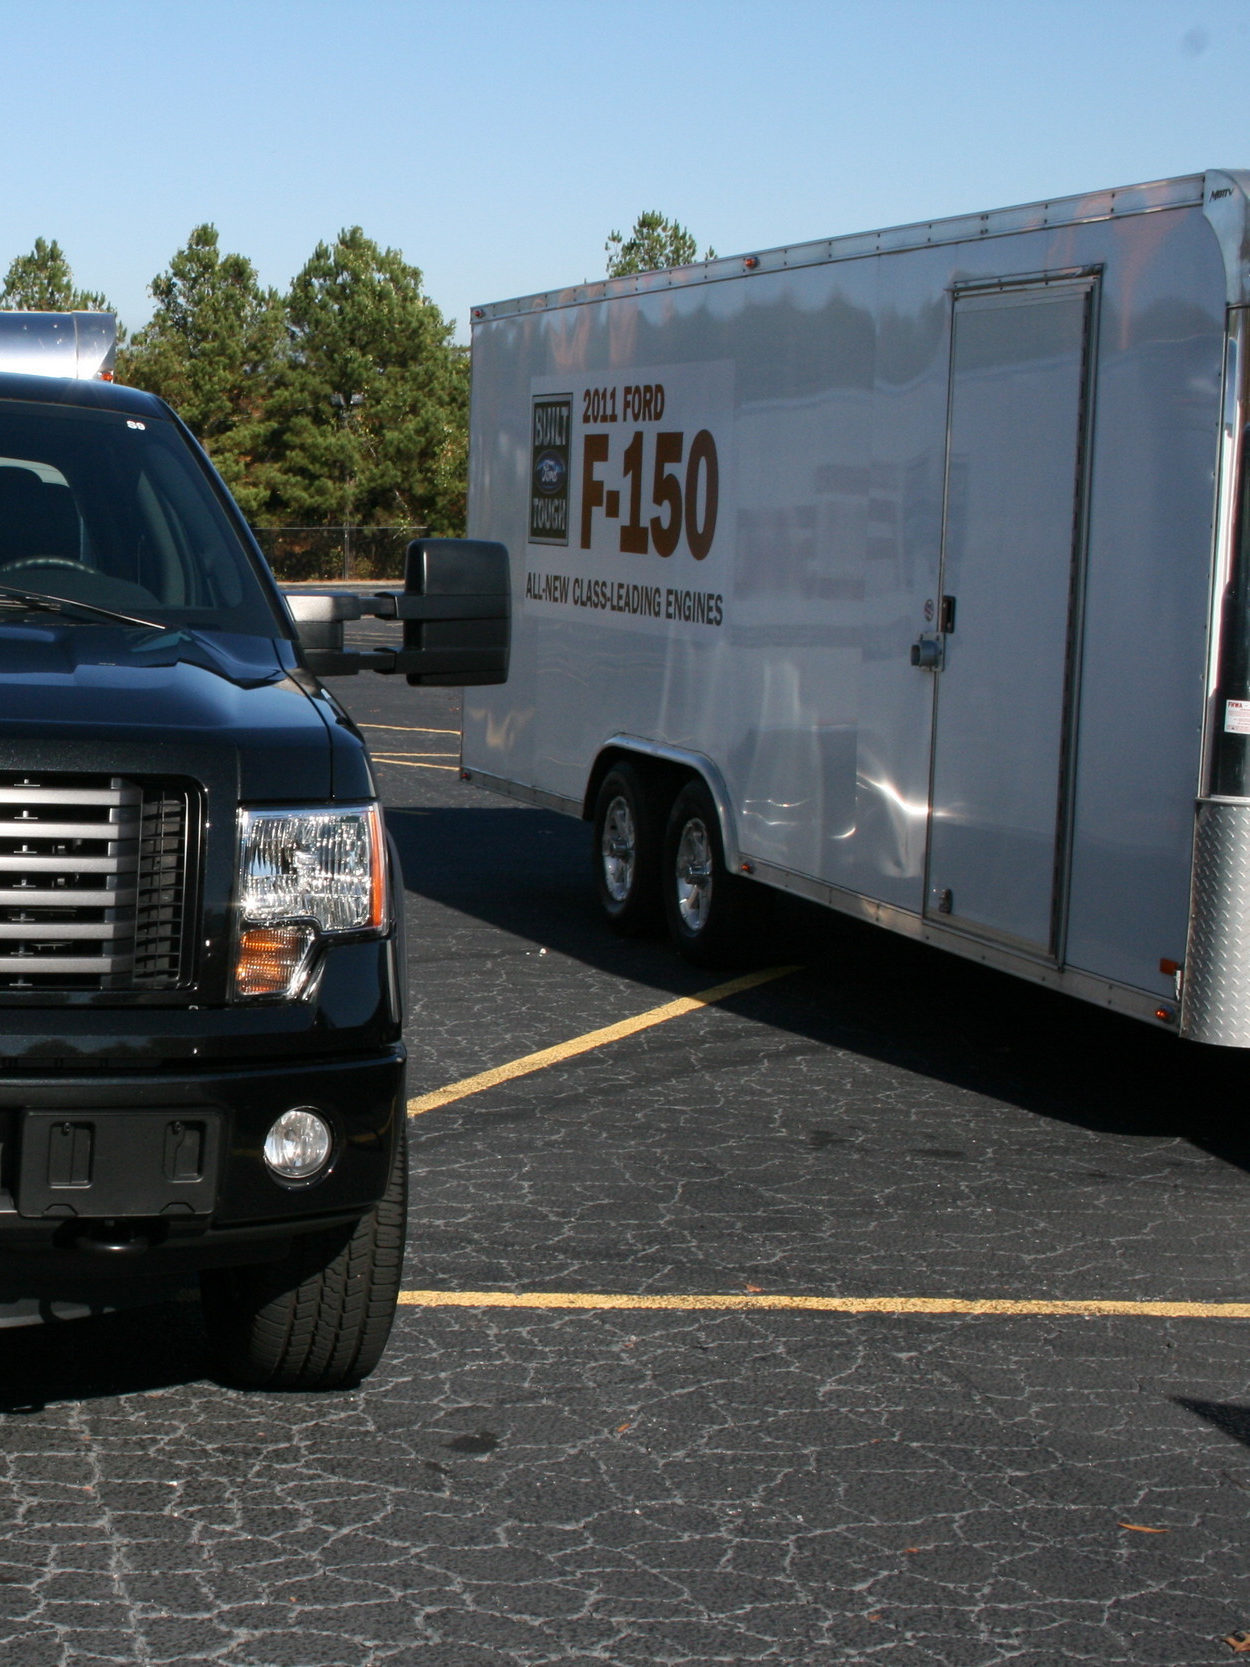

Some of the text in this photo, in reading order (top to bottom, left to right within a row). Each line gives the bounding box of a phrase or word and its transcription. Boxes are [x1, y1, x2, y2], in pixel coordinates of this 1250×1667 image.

[582, 383, 665, 424] 2011 FORD
[534, 405, 569, 446] BUILT
[532, 497, 567, 531] TOUGH
[580, 428, 719, 561] F-150
[525, 571, 724, 627] ALL-NEW CLASS-LEADING ENGINES
